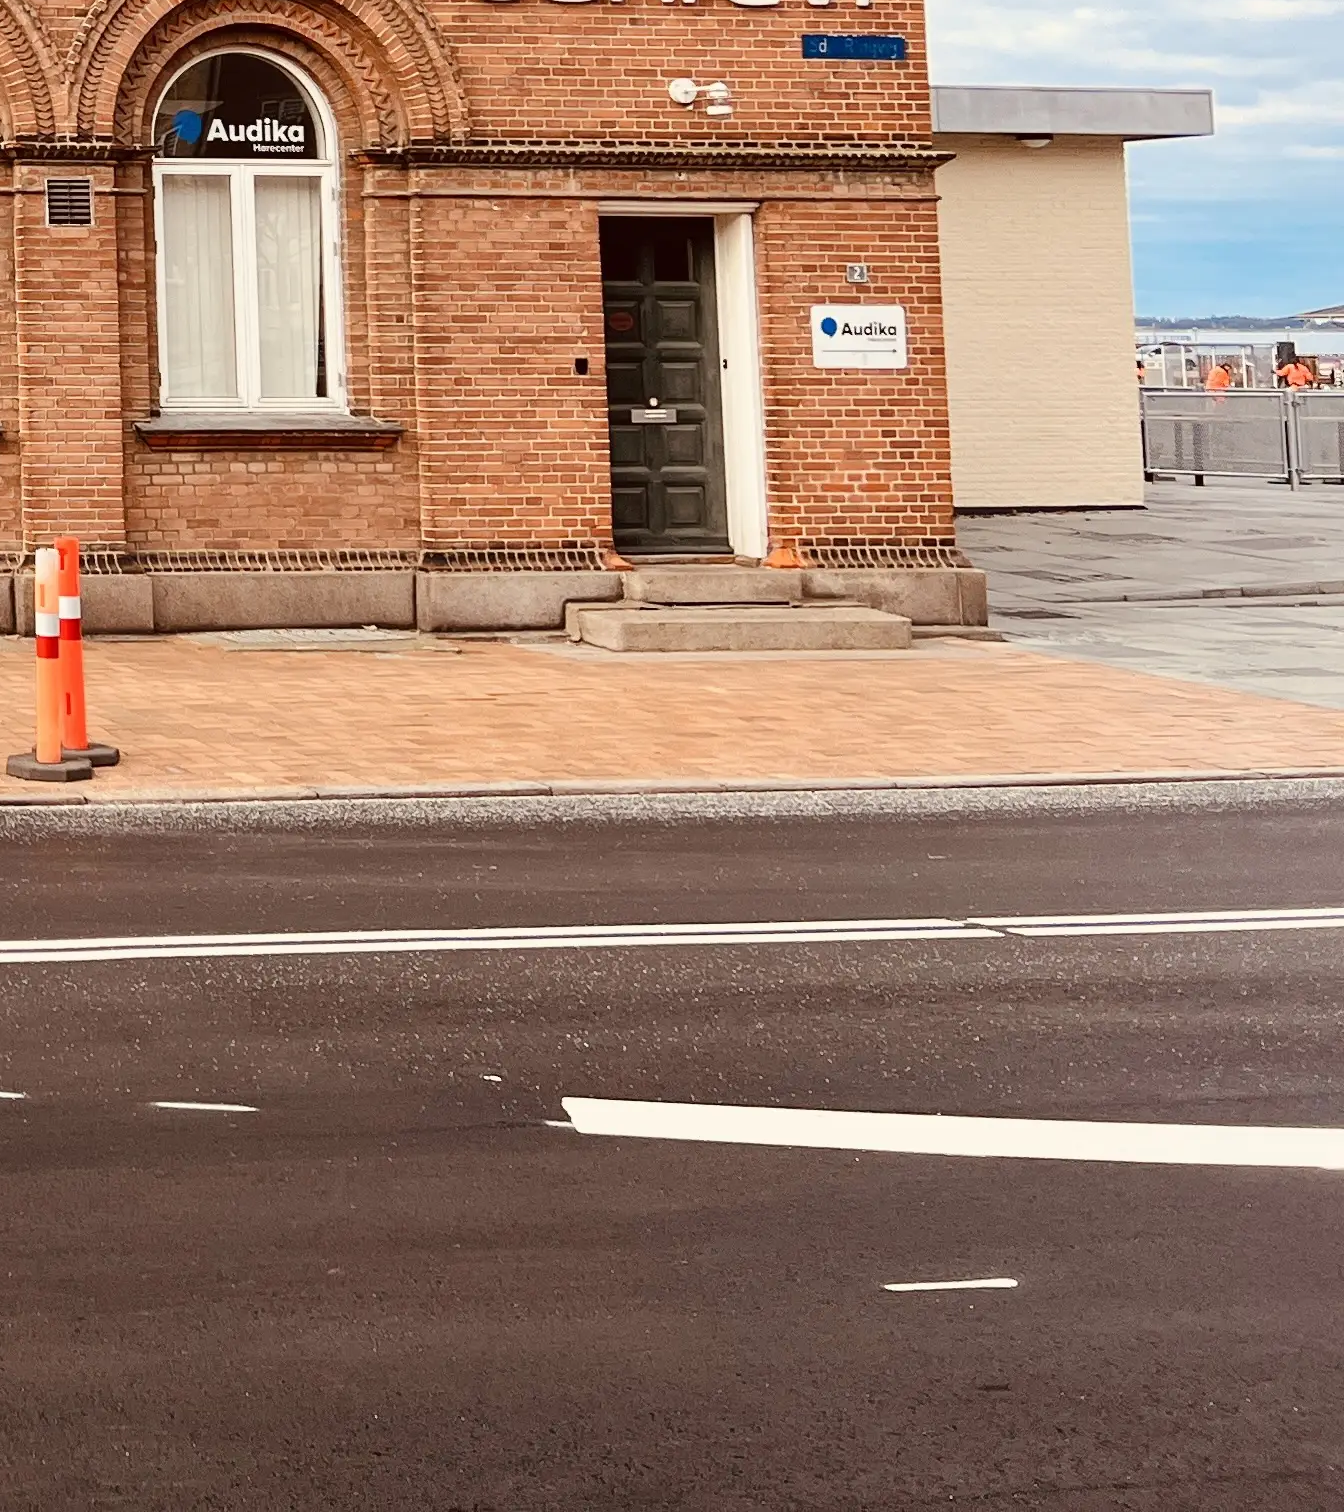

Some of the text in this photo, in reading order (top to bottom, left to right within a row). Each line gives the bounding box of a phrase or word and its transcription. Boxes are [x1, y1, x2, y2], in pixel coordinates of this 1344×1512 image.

[206, 117, 305, 143] Audika
[853, 266, 862, 280] 2
[841, 321, 897, 336] Audika
